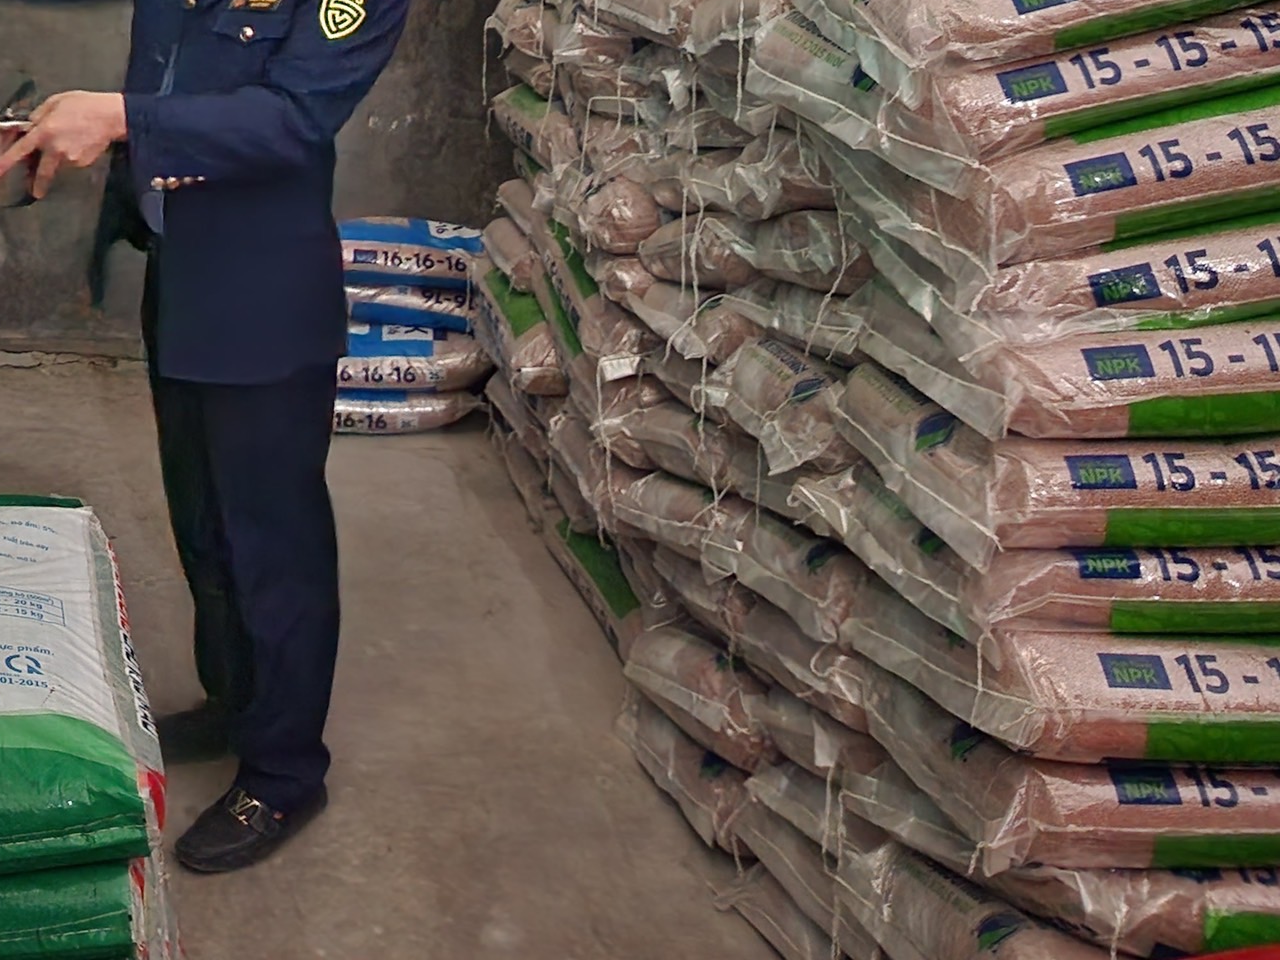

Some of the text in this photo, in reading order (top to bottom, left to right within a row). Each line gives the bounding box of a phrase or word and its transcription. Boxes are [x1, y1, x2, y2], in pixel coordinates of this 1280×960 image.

[1011, 76, 1055, 98] NPK
[1070, 47, 1122, 89] 15
[1155, 30, 1209, 71] 15
[1138, 140, 1193, 182] 15
[1227, 123, 1280, 165] 15
[382, 250, 467, 273] 16-16-16
[1164, 249, 1219, 293] 15
[1096, 338, 1214, 378] NPK 15
[1079, 450, 1280, 491] NPK 15 15
[1086, 558, 1130, 573] NPK
[1146, 549, 1201, 582] 15
[29, 601, 43, 609] kg
[1112, 654, 1230, 694] NPK 15
[1183, 765, 1239, 807] 15
